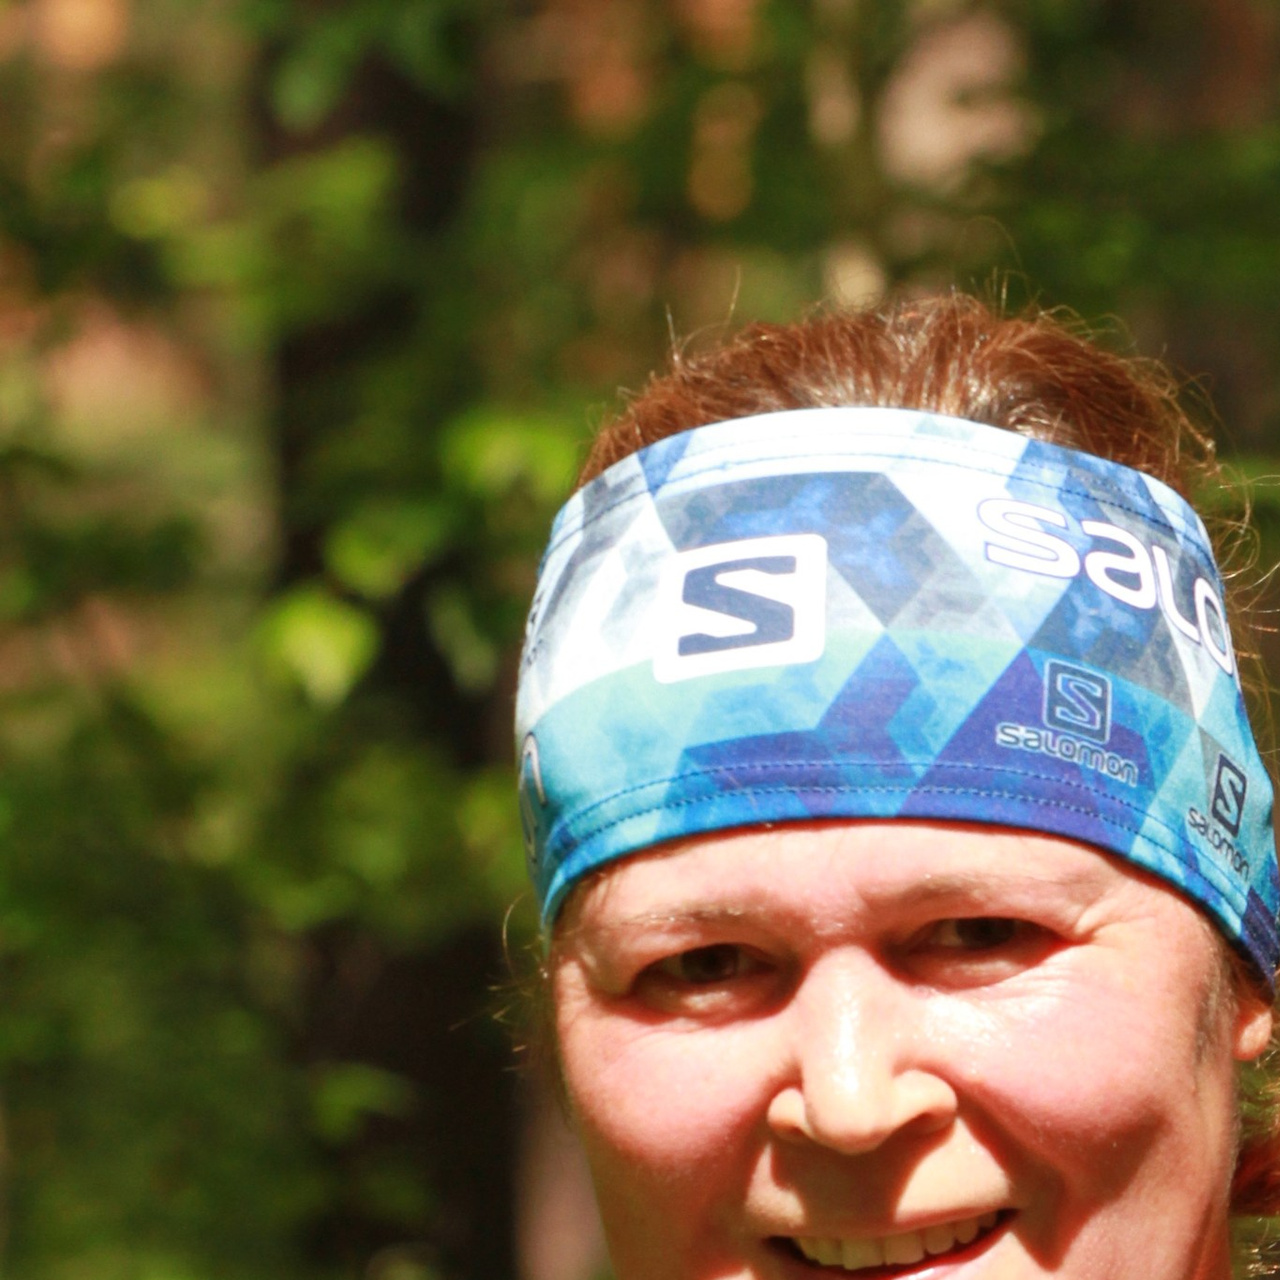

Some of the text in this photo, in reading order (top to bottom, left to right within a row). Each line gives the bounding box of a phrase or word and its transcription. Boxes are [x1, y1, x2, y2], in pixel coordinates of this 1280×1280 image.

[977, 498, 1240, 690] salo
[995, 721, 1138, 788] salomon
[1187, 806, 1250, 881] salomon
